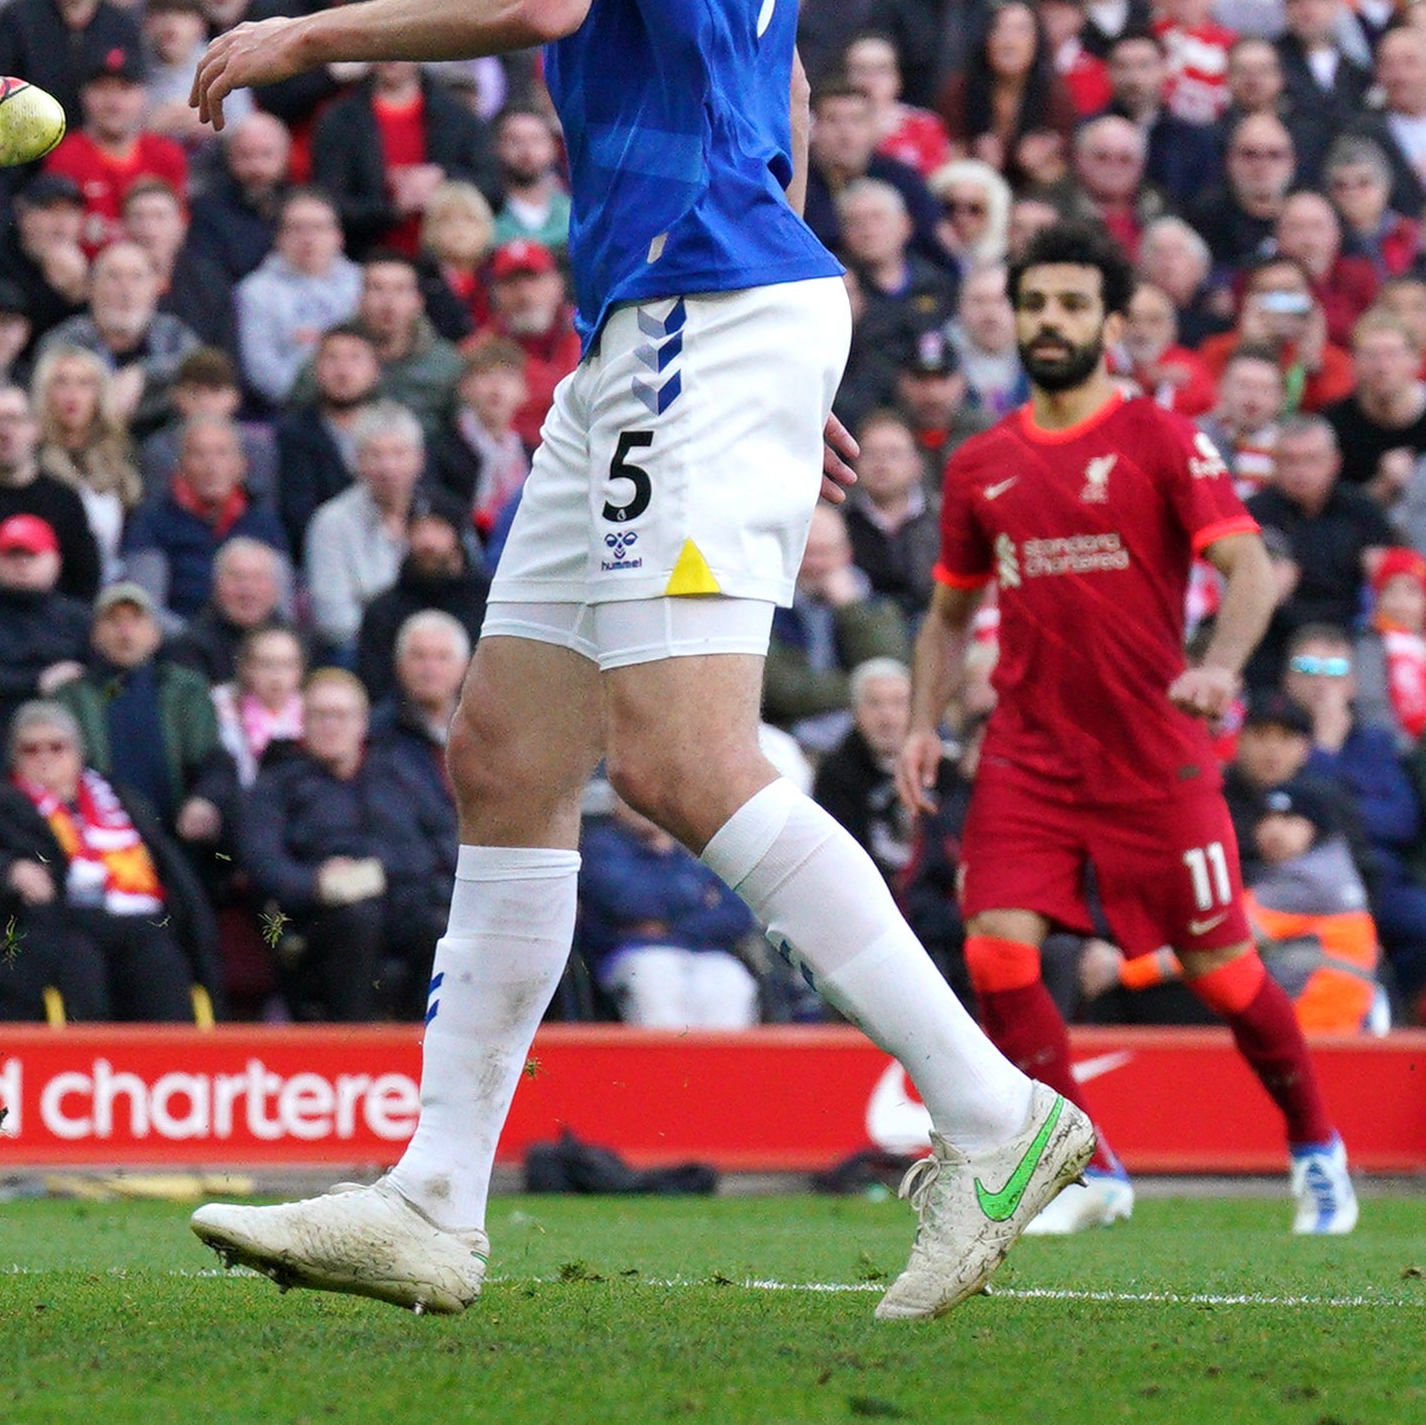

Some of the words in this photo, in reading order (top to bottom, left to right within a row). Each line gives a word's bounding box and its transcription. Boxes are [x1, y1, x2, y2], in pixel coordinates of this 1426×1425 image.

[602, 430, 655, 523] 5
[1183, 841, 1232, 912] 11
[40, 1057, 420, 1141] chartere
